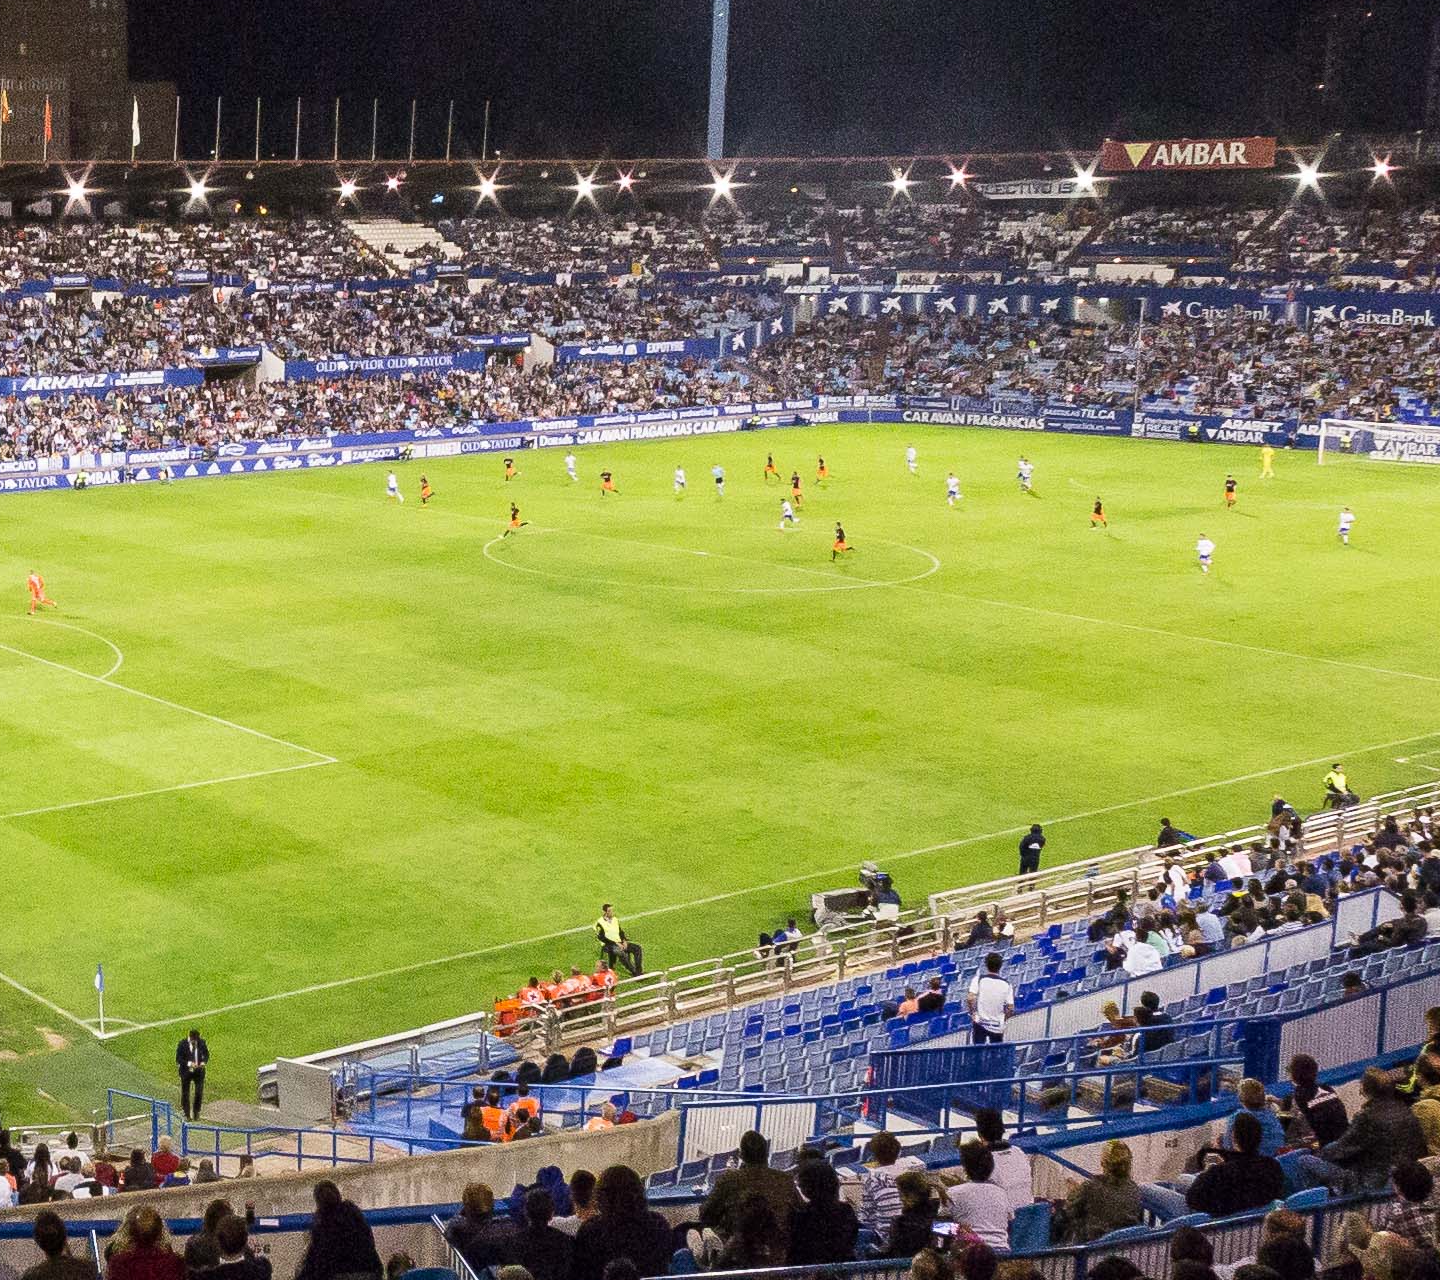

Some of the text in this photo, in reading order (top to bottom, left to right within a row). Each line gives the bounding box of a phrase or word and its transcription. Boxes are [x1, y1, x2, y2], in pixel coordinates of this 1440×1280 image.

[1151, 142, 1249, 166] AMBAR
[1338, 305, 1436, 328] CaixaBank
[315, 355, 453, 373] OLD TAYLOR OLD TAYLOR
[903, 409, 966, 424] CARAVAN
[967, 413, 1045, 430] FRAGANCIAS
[1081, 408, 1117, 420] TILCA
[578, 426, 629, 444] CARAVAN
[631, 423, 693, 440] FRAGANCIAS
[1216, 430, 1265, 443] AMBAR
[461, 441, 480, 452] OLD
[489, 437, 521, 450] TAYLOR
[15, 476, 58, 490] TAYLOR
[83, 471, 119, 488] MBAR
